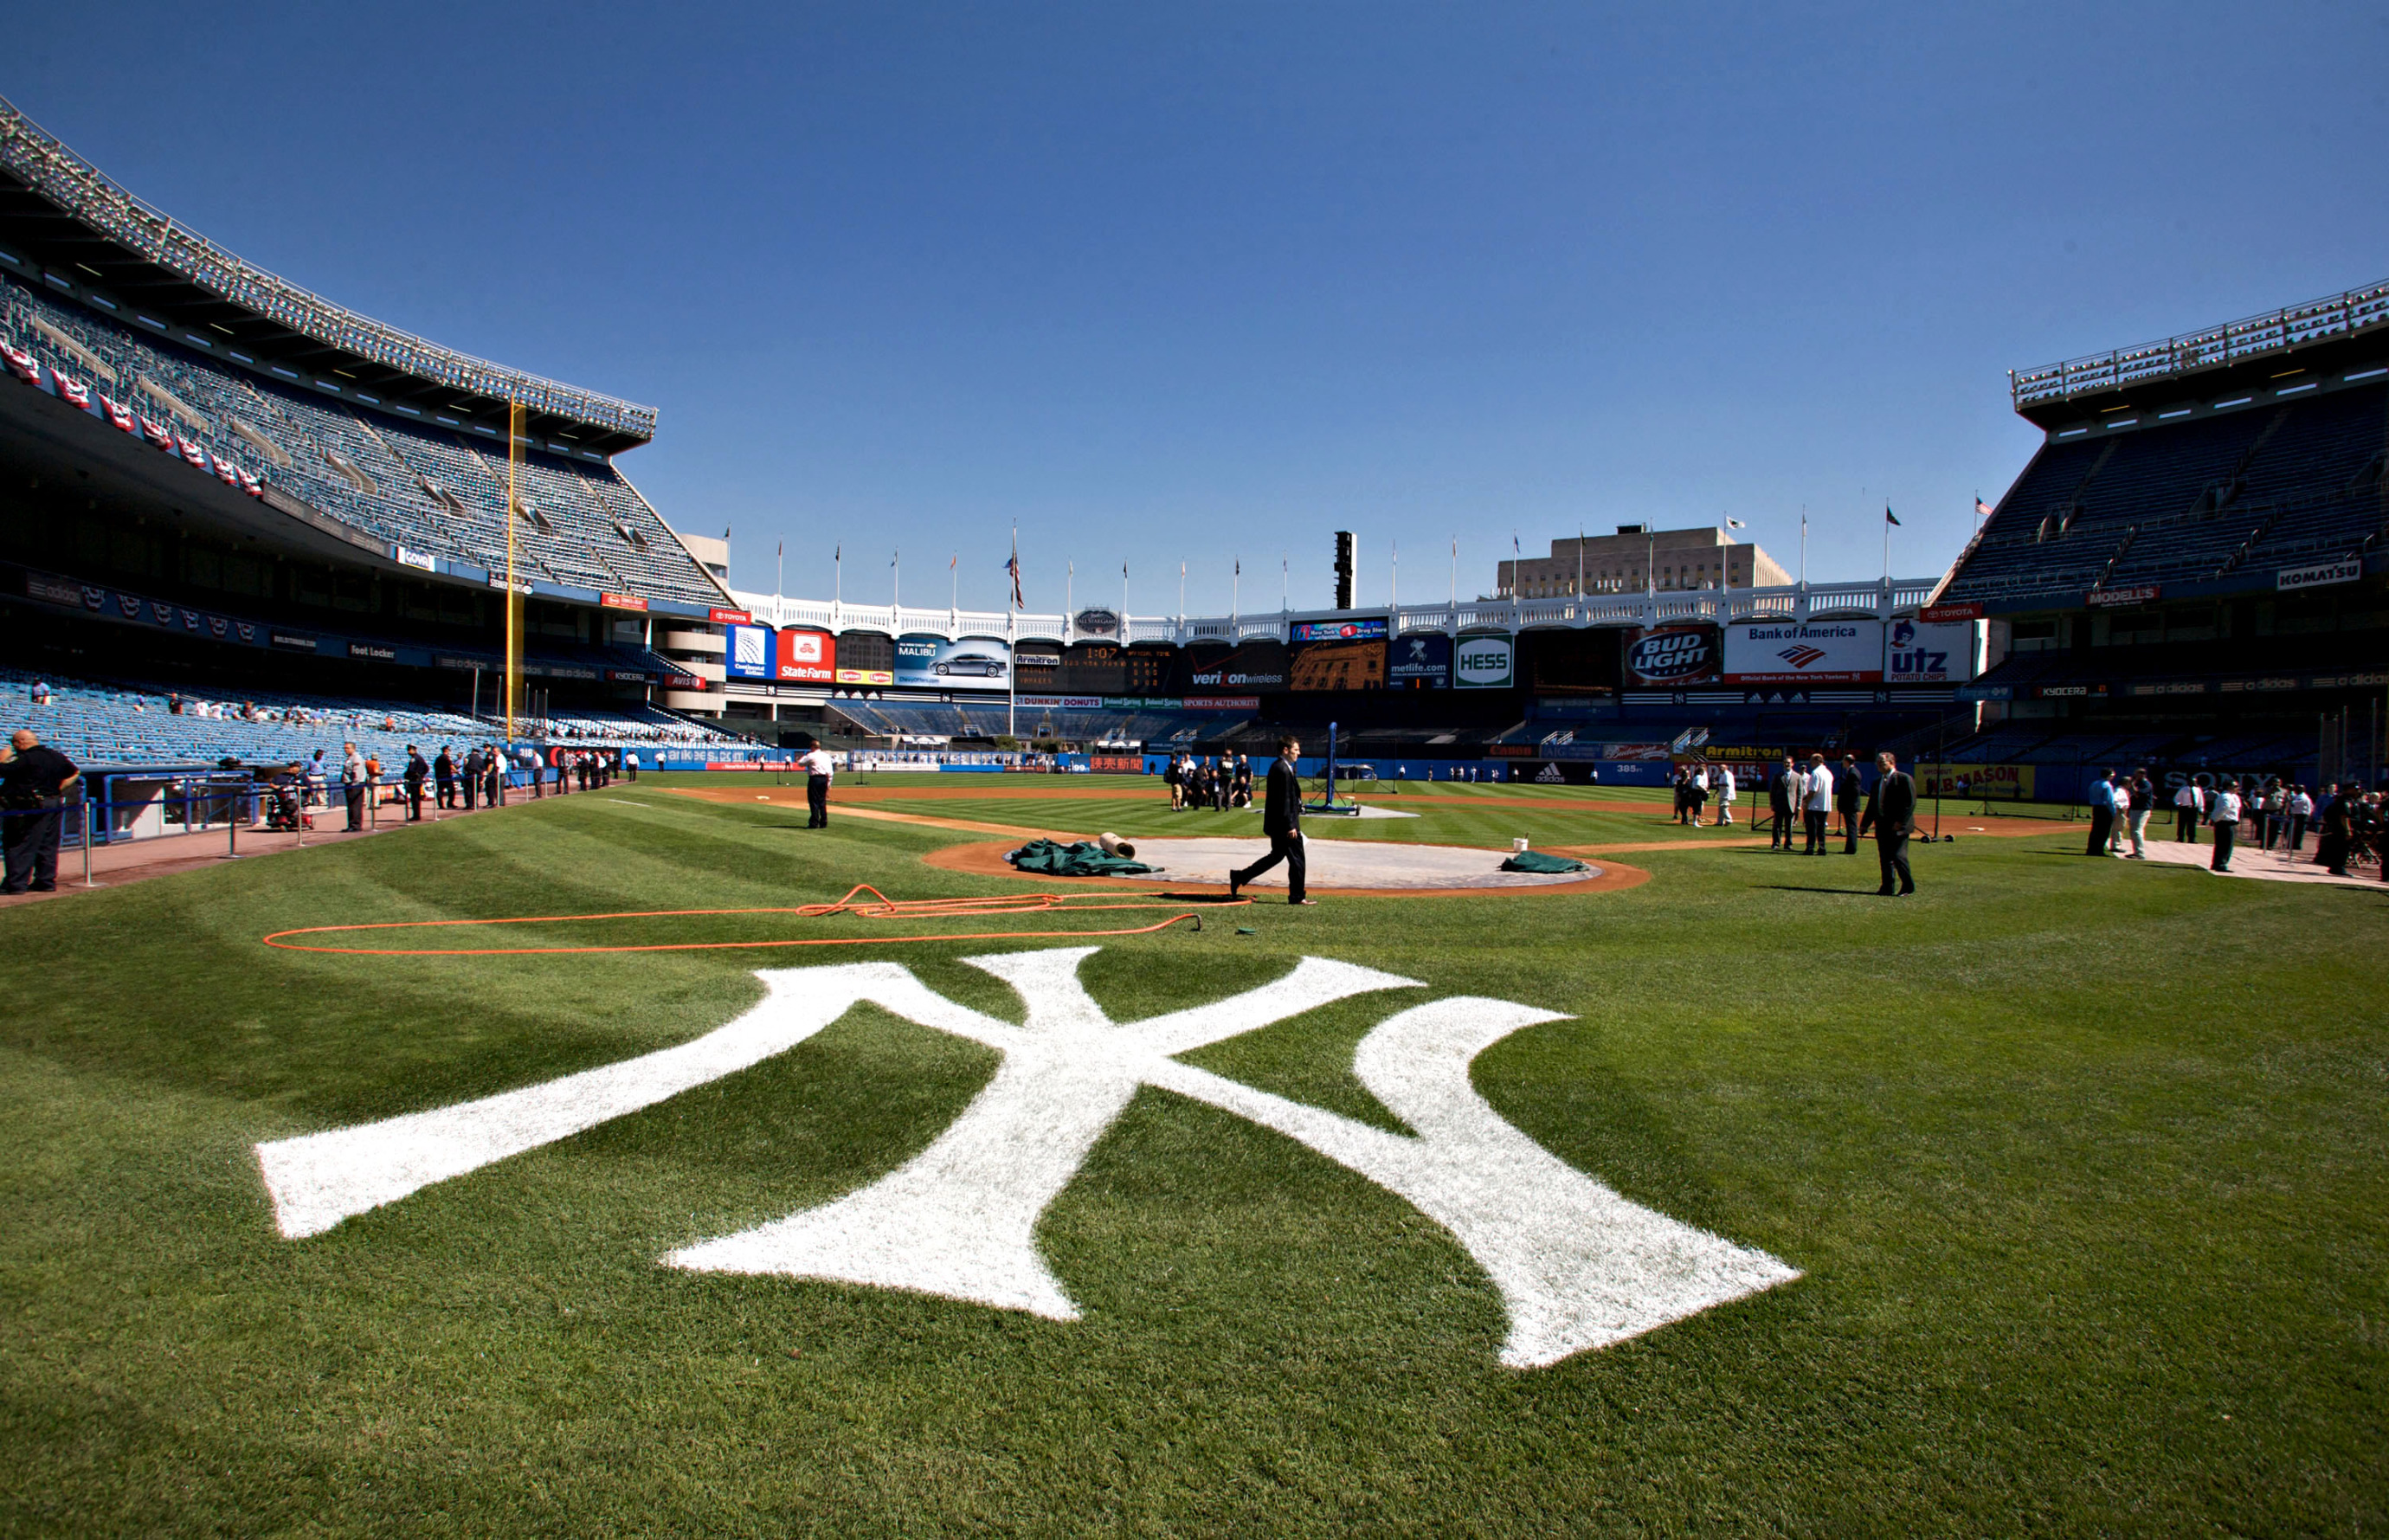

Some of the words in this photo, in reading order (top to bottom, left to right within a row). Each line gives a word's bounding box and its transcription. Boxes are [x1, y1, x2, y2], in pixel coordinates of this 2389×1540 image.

[406, 551, 429, 568] GOYA
[2280, 564, 2358, 586] KOMATSU
[2090, 588, 2154, 604] MODELL'S
[724, 613, 747, 622] TOYOTA
[1940, 609, 1974, 617] TOYOTA
[1749, 628, 1782, 640] Bank
[1783, 627, 1798, 639] of
[1800, 625, 1857, 638] America
[1643, 634, 1702, 655] BUD
[351, 645, 369, 655] Foot
[370, 647, 396, 659] Locker
[898, 648, 936, 657] MALIBU
[1087, 648, 1117, 659] 1:07
[1017, 654, 1058, 664] Armitron
[1460, 654, 1507, 671] HESS
[1634, 646, 1710, 670] LIGHT
[782, 666, 806, 678] State
[807, 667, 832, 680] Farm
[1391, 662, 1446, 673] metlife.com
[615, 673, 645, 681] KYOCERA
[840, 671, 861, 680] Lipton
[870, 673, 891, 682] Lipton
[1193, 670, 1247, 688] verizon
[1246, 673, 1283, 684] wireless
[672, 677, 691, 686] AVIS
[2245, 677, 2296, 691] adidas
[2042, 686, 2088, 696] KYOCERA
[2155, 682, 2205, 693] adidas
[1024, 697, 1062, 706] DUNKIN'
[1123, 698, 1142, 706] Spring
[1164, 698, 1182, 707] Spring
[1183, 699, 1213, 707] SPORTS
[1214, 698, 1259, 707] AUTHORITY
[660, 749, 744, 763] ankees.com
[1489, 745, 1533, 757] Canon
[1705, 746, 1782, 757] Armitron
[1090, 757, 1143, 770] 読売新聞
[1535, 775, 1566, 783] adidas
[2164, 770, 2277, 790] SONY
